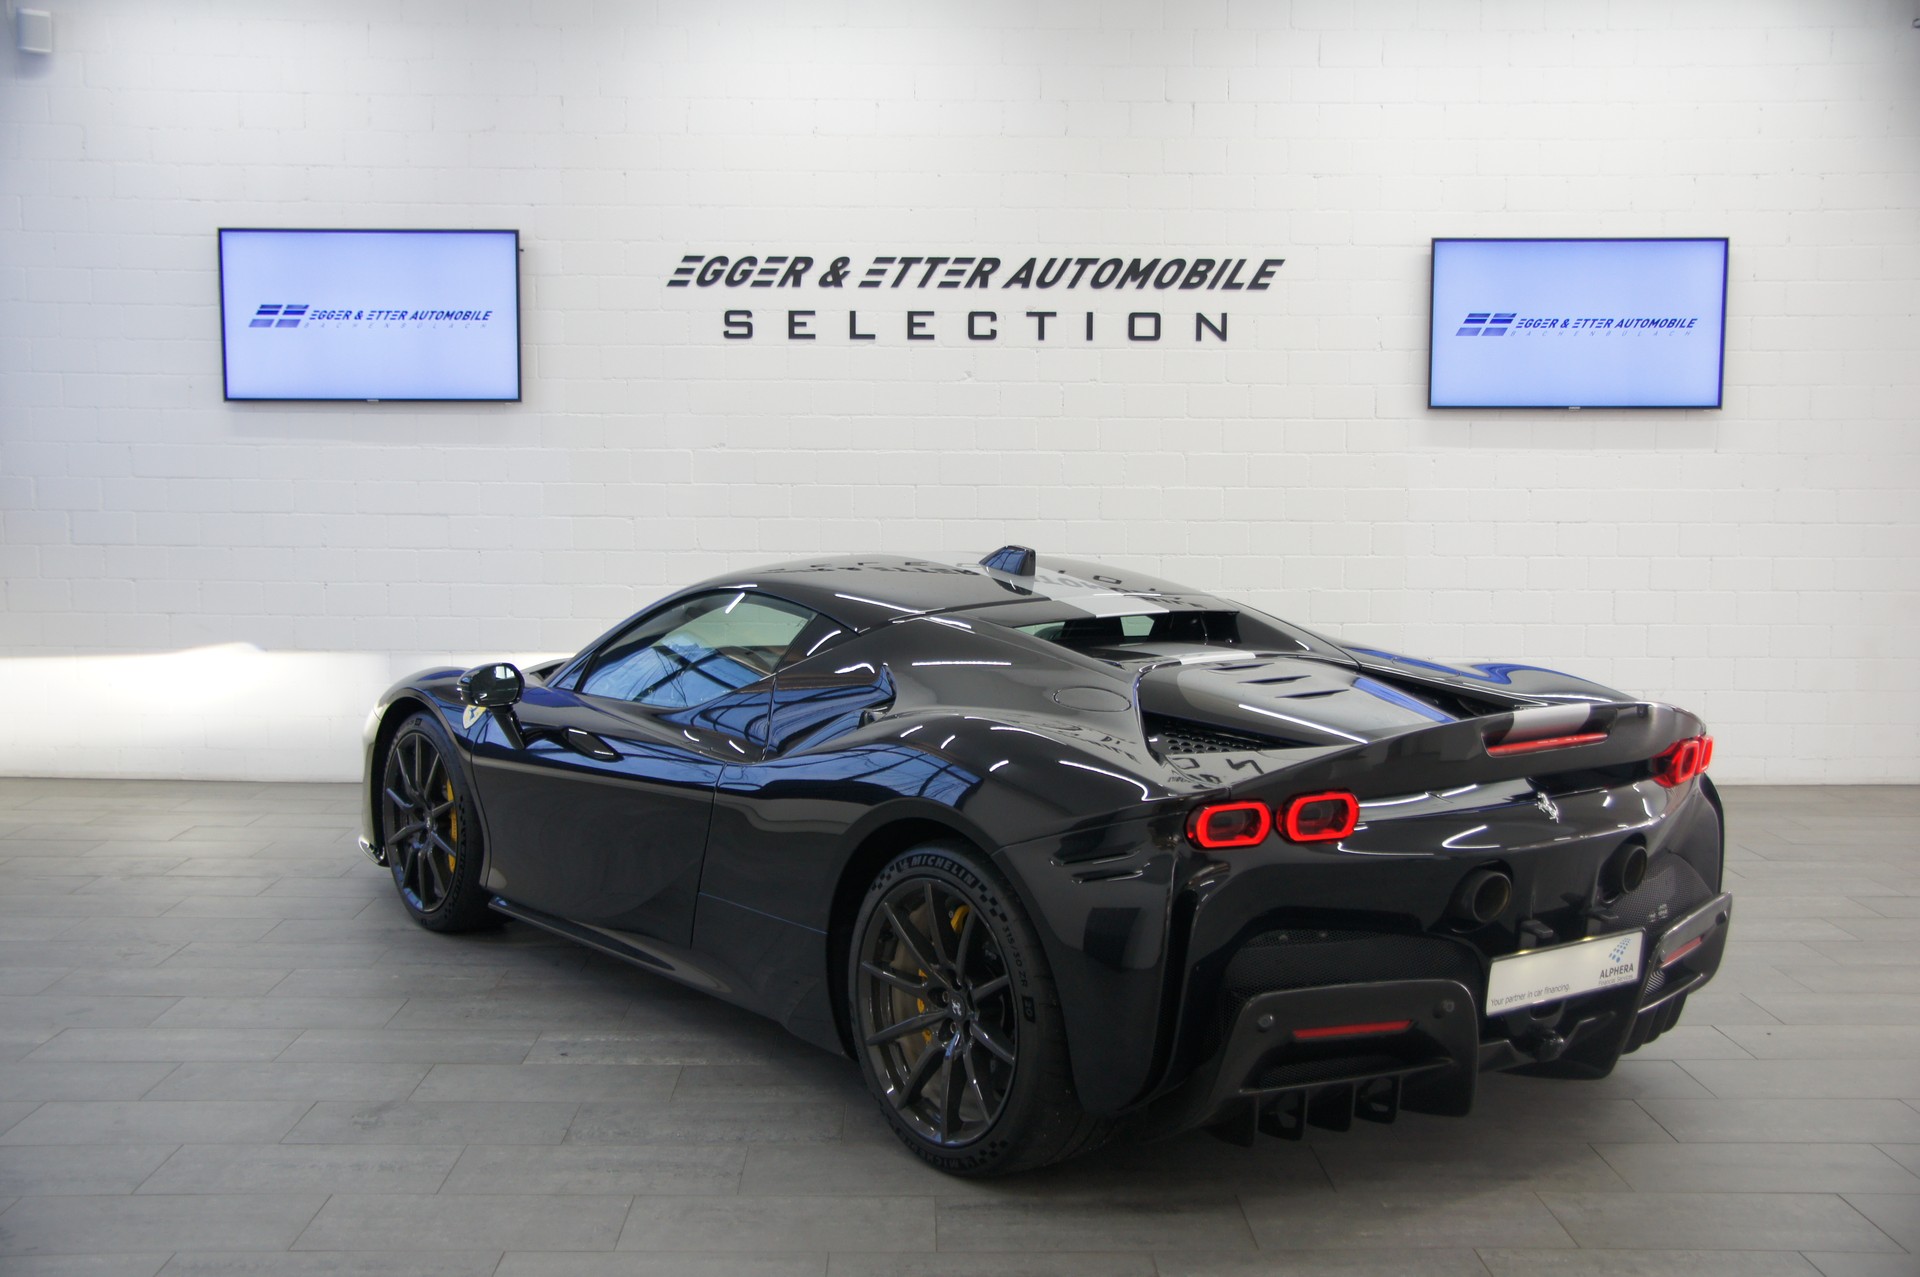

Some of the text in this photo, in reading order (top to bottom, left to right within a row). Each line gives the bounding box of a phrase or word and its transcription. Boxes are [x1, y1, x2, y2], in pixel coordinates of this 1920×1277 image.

[667, 255, 1286, 290] EGGER & ETTER AUTOMOBILE
[309, 310, 493, 321] EGGER & ETTER AUTOMOBILE
[1515, 318, 1698, 329] EGGER & ETTER AUTOMOBILE
[723, 309, 1228, 342] SELECTION
[911, 855, 976, 886] MICHELIN
[1599, 963, 1634, 979] ALPHERA
[1491, 998, 1504, 1007] Your
[1505, 993, 1526, 1005] partner
[1527, 990, 1533, 998] in
[1533, 989, 1543, 998] car
